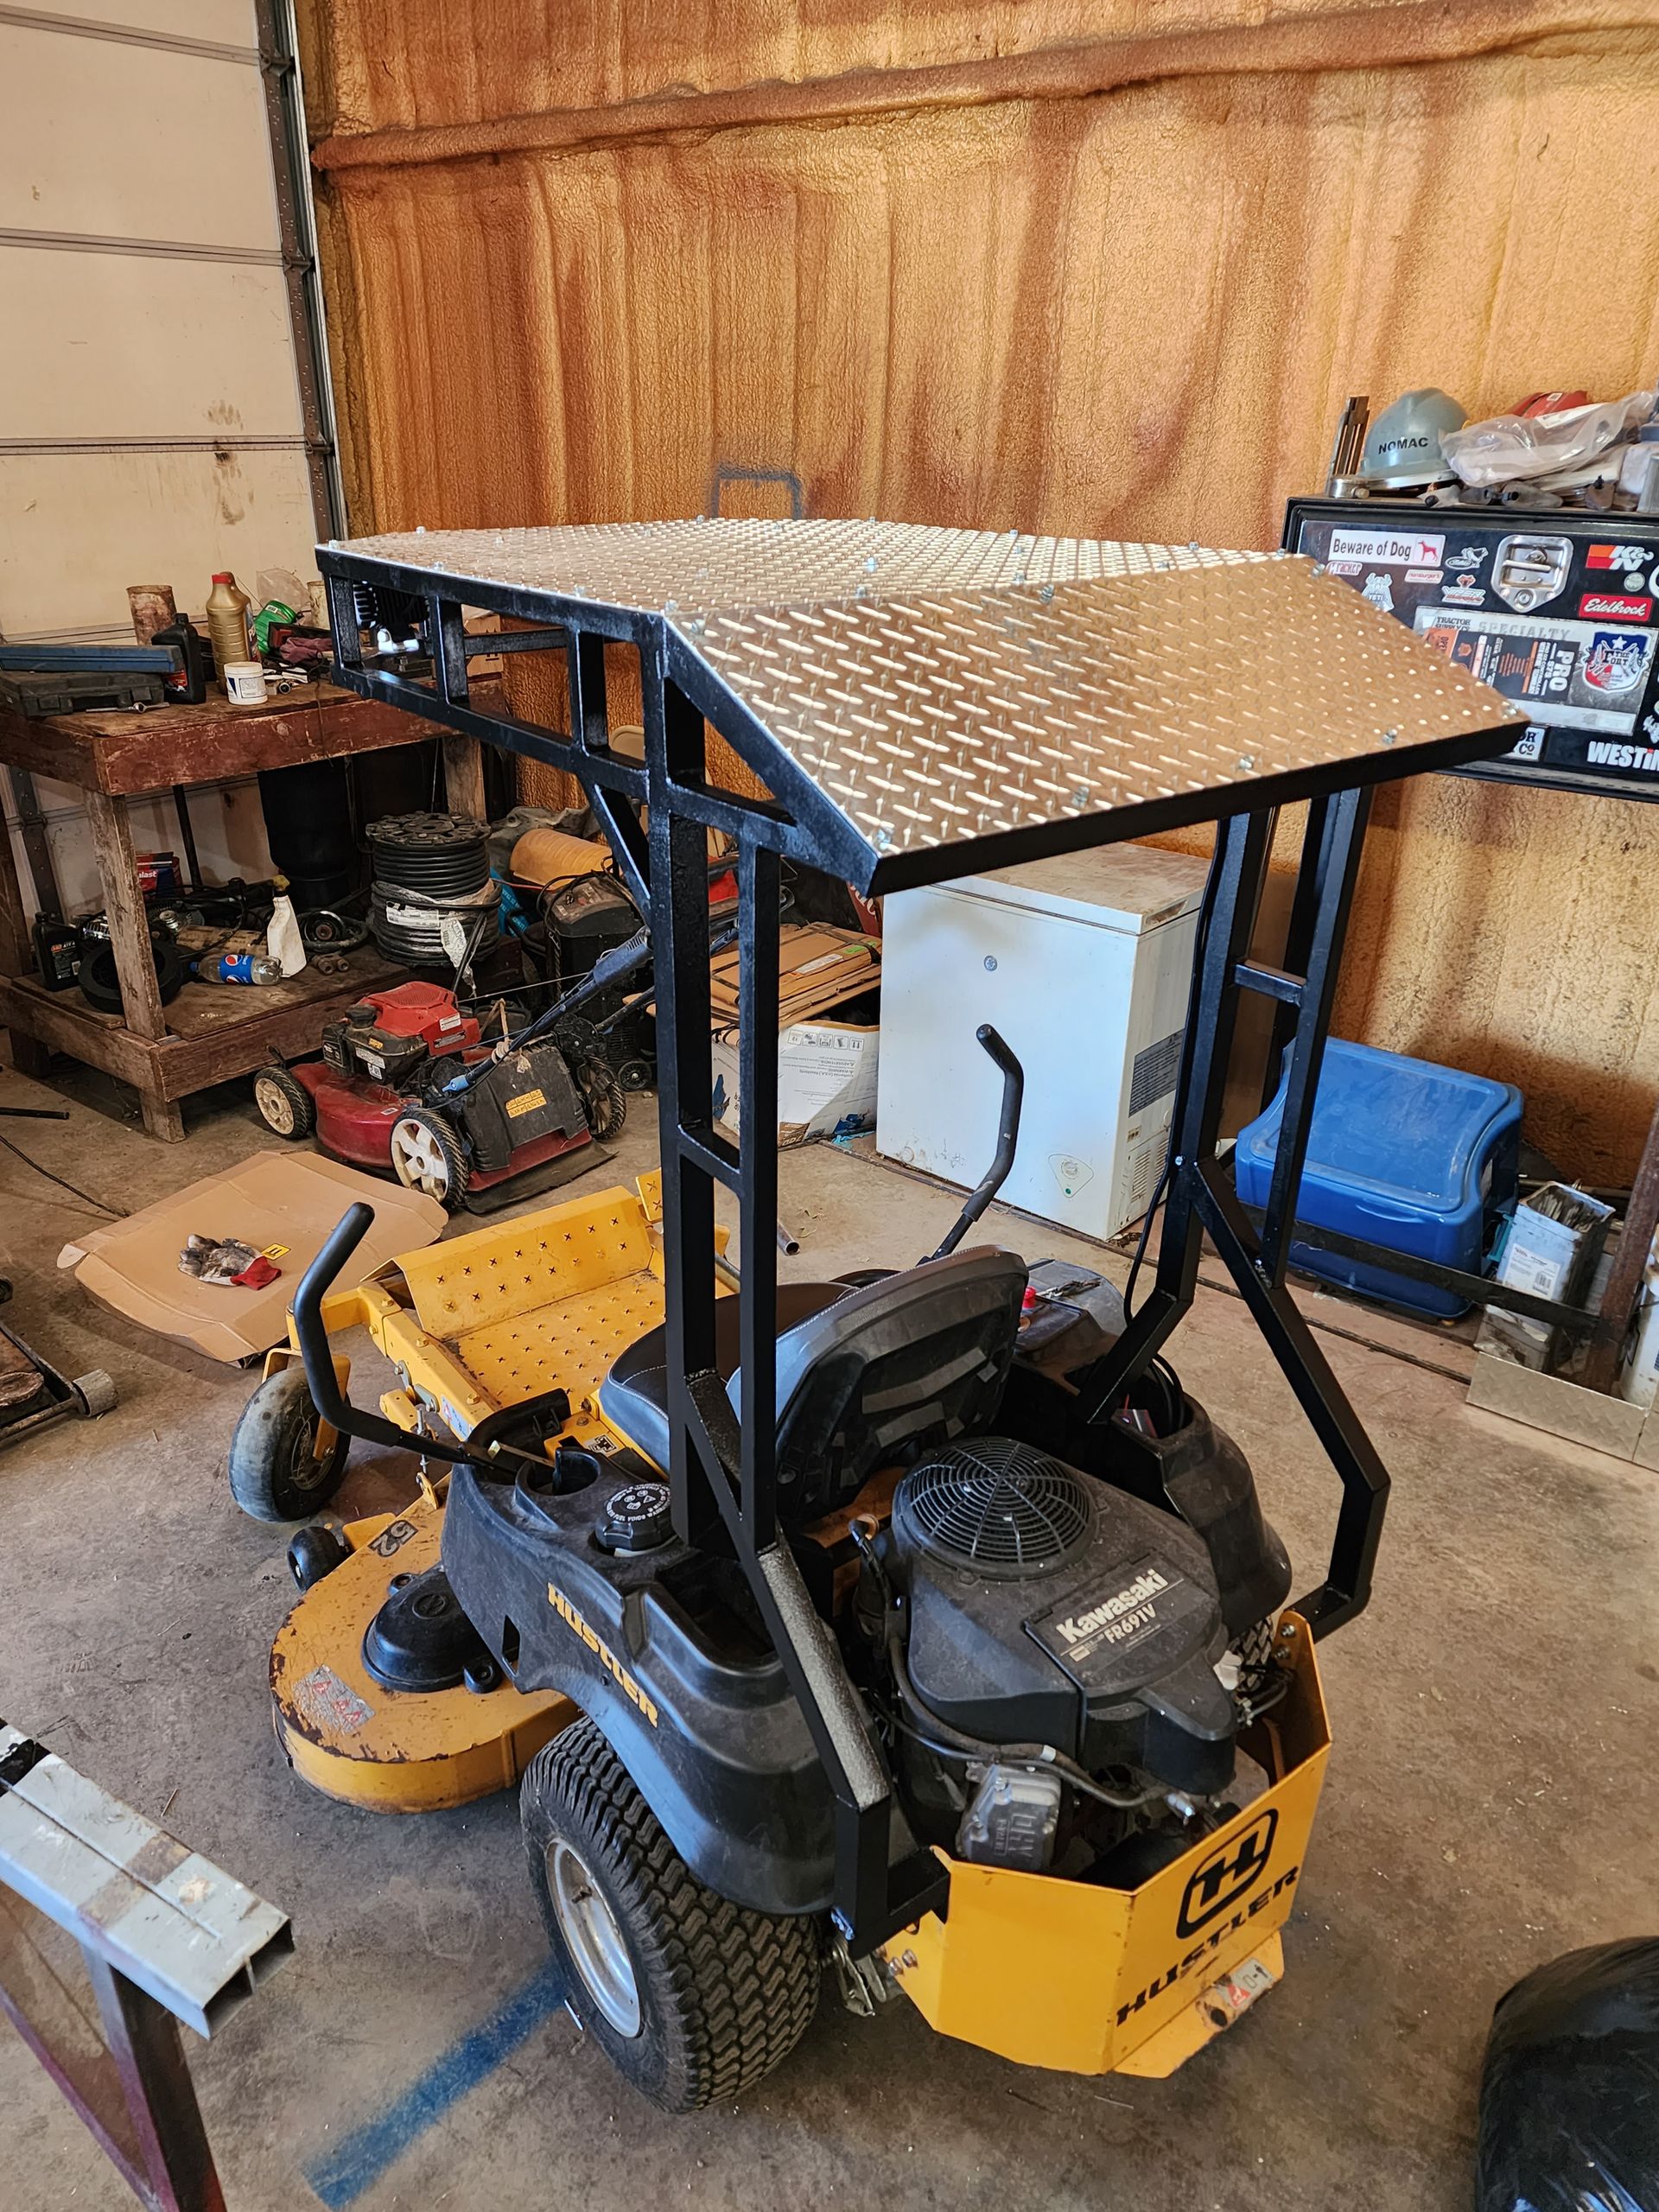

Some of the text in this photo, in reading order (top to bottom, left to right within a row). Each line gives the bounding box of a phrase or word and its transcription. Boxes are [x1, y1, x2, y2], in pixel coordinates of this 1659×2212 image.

[1378, 436, 1429, 454] NOMAC
[1333, 538, 1412, 561] Beware of Dog
[1437, 616, 1471, 625] TRACTOR
[1584, 598, 1647, 616] Edelbrock
[1478, 621, 1571, 639] SPECIALTY
[1548, 650, 1575, 691] PRO
[371, 1521, 416, 1556] 52
[1056, 1568, 1169, 1643] Kawasaki
[1104, 1603, 1156, 1643] FR691V
[548, 1582, 658, 1728] HUSTLER
[1116, 1866, 1299, 2027] HUSTLER
